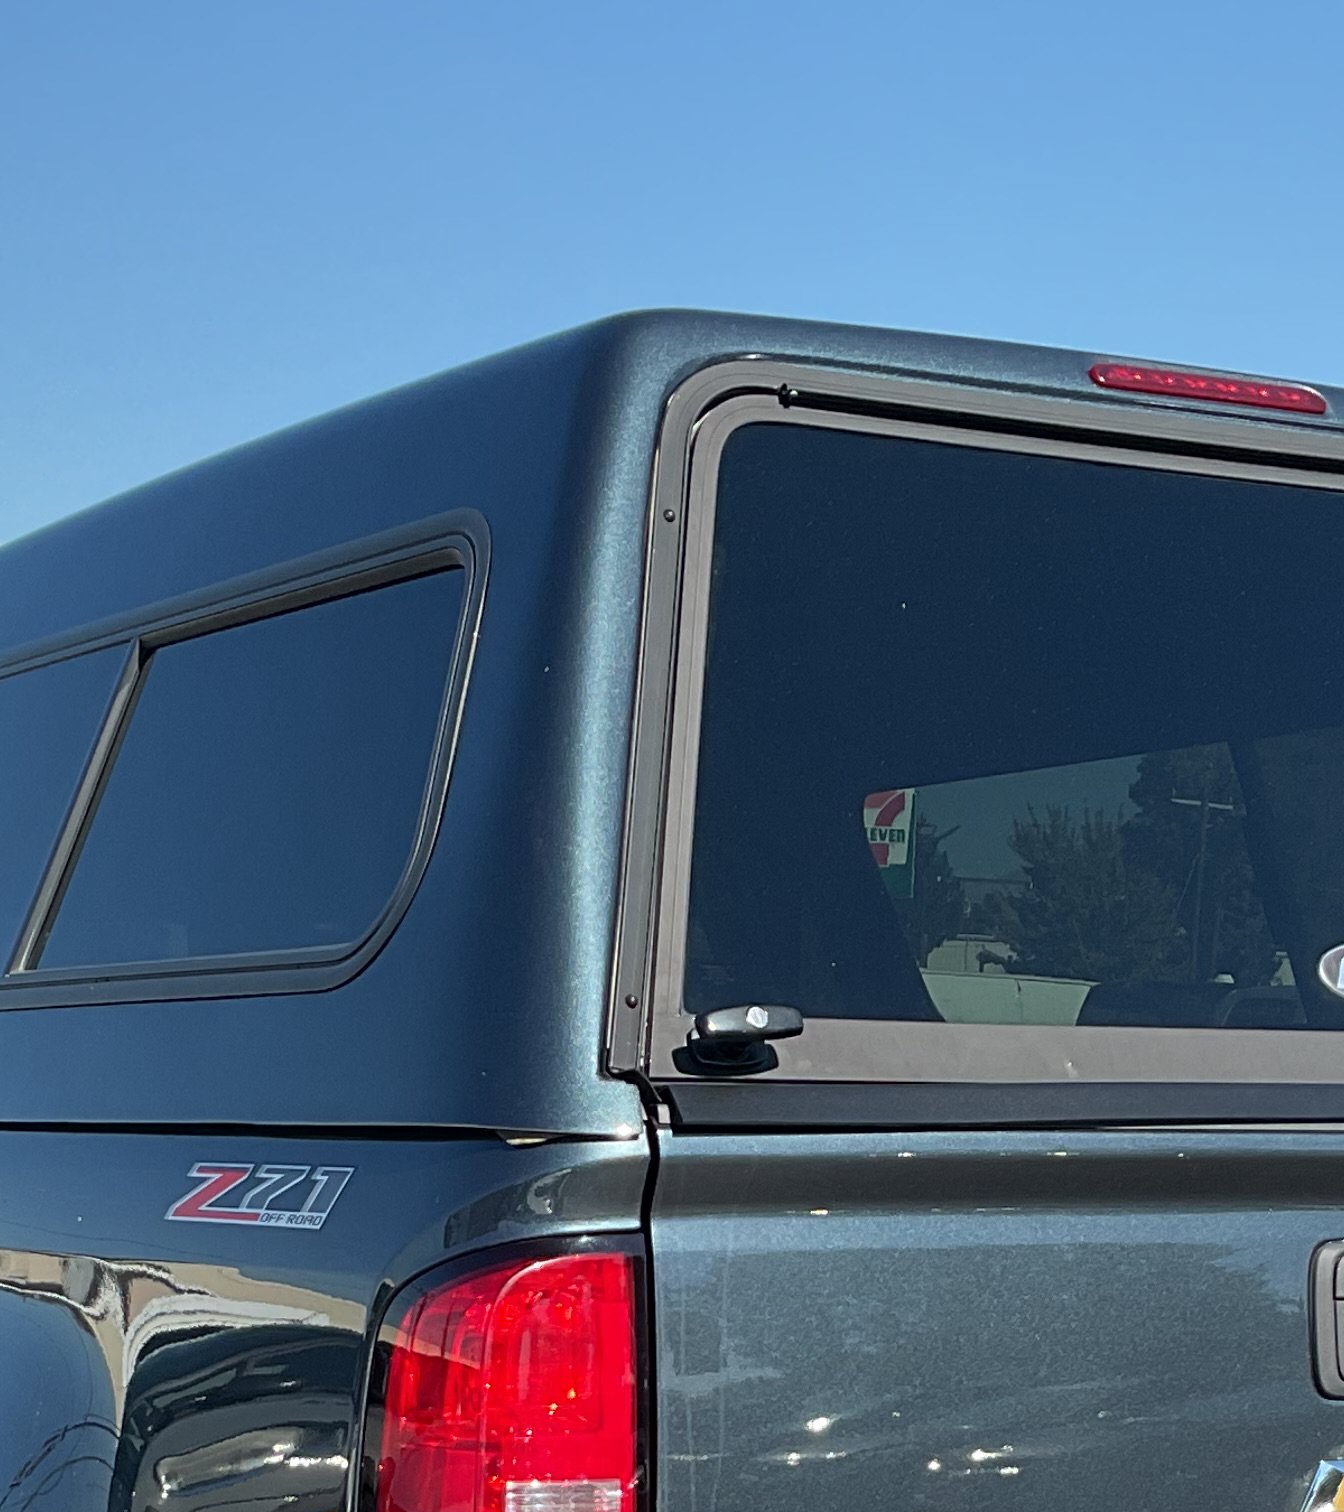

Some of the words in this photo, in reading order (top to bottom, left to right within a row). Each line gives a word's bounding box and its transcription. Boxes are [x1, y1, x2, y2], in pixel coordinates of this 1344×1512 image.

[164, 1162, 355, 1226] Z71
[259, 1213, 284, 1224] OFF
[288, 1214, 322, 1226] ROAD
